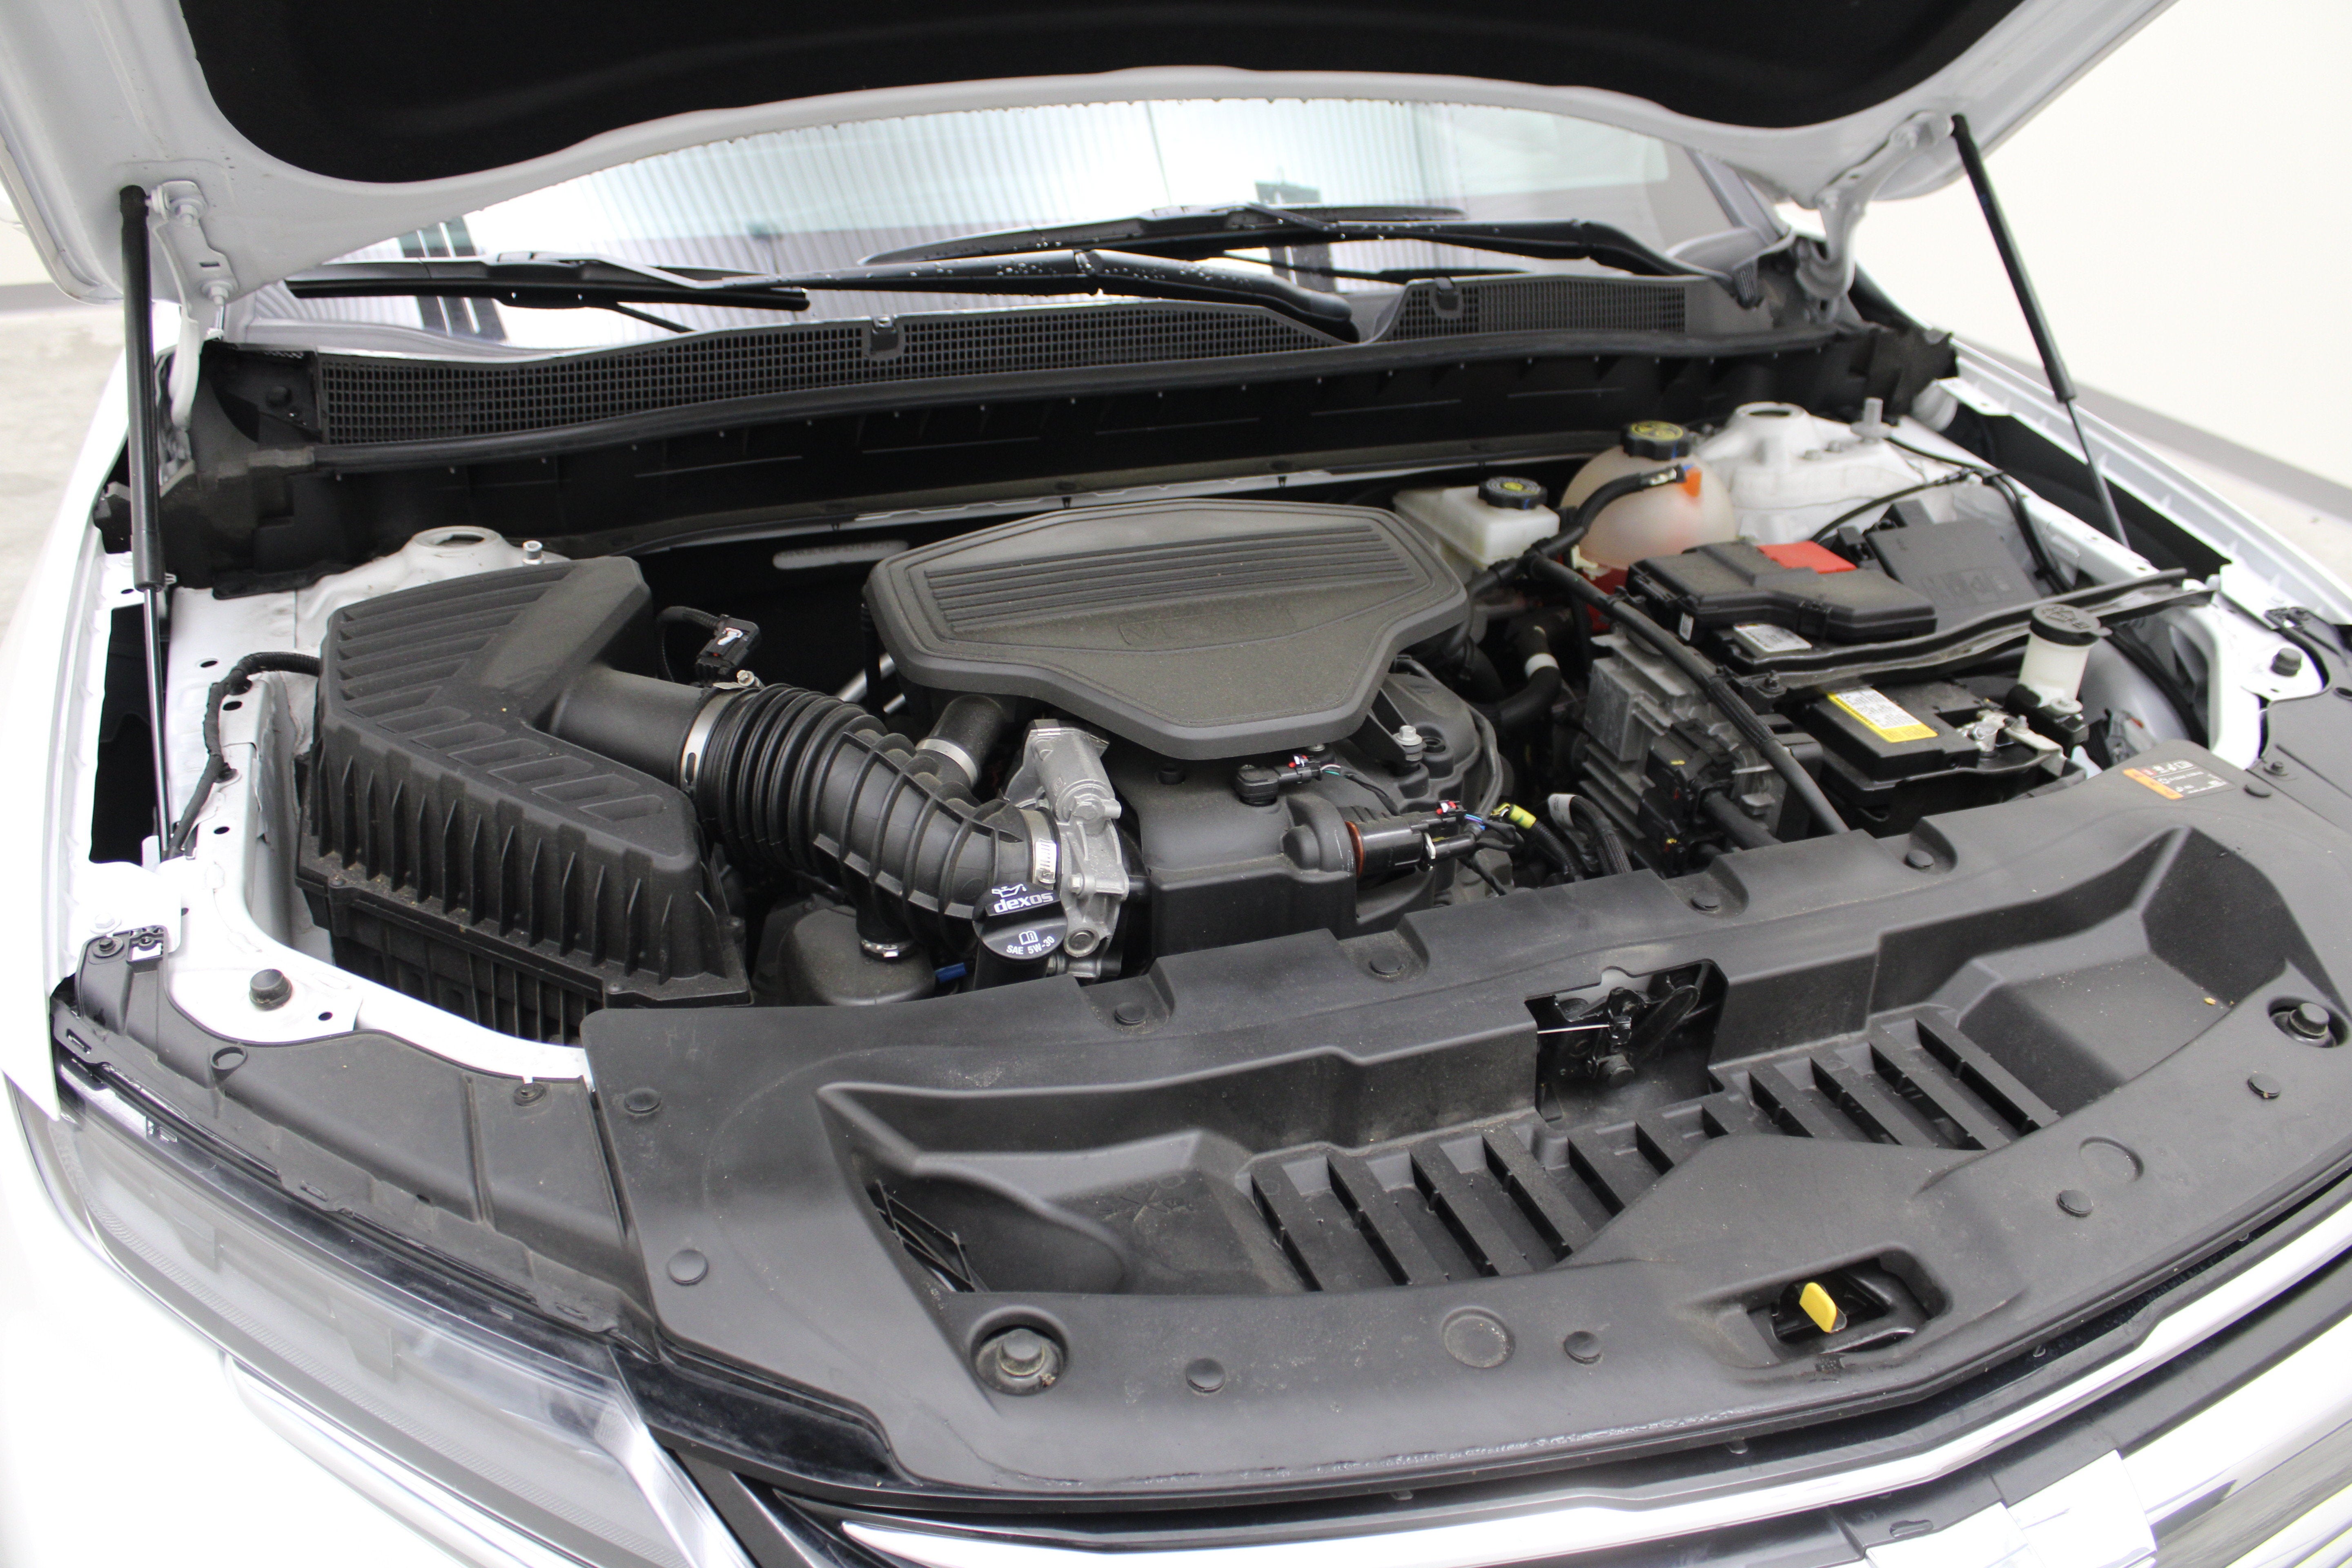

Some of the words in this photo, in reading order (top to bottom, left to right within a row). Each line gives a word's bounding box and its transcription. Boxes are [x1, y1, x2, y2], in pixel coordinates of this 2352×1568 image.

[994, 893, 1054, 913] dexos
[1007, 945, 1023, 955] SAE
[1028, 936, 1055, 954] 5W-30
